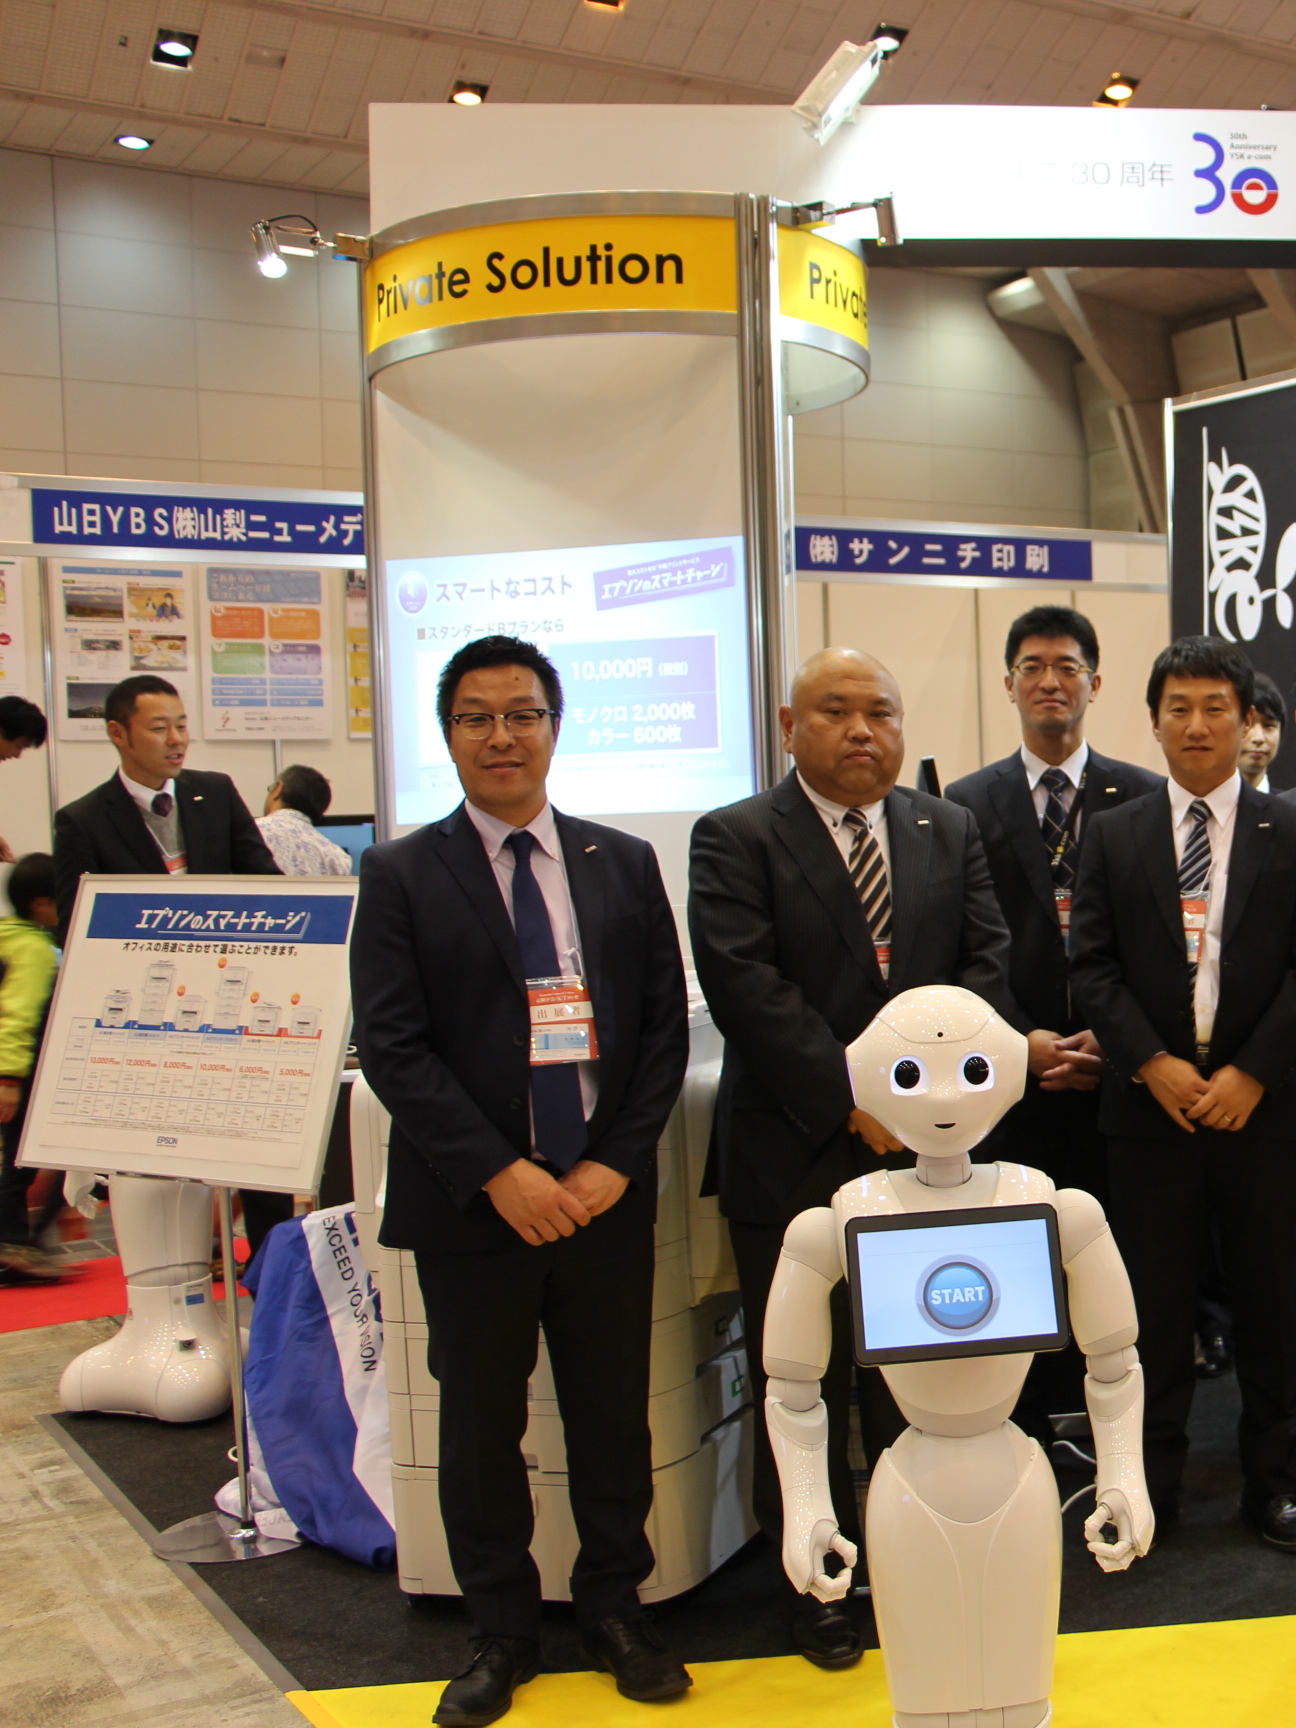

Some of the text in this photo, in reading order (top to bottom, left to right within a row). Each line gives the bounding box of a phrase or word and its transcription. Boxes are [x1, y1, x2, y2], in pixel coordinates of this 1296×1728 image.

[1229, 132, 1248, 140] 30th
[1229, 142, 1278, 152] Anniversary
[1229, 152, 1246, 160] YSK
[376, 242, 684, 323] Private Solution
[435, 574, 573, 602] スマートなコスト
[571, 657, 653, 681] 10,000円
[572, 702, 696, 724] モノクロ 2,000枚
[587, 724, 682, 746] カラー 600枚
[135, 907, 306, 931] エプソンのスマートチャージ
[122, 941, 299, 957] オフィスの用途に合わせて選ぶことができます。
[156, 1136, 179, 1145] EPSON
[322, 1215, 355, 1281] EXCEED
[346, 1281, 369, 1329] YOUR
[931, 1285, 986, 1305] START
